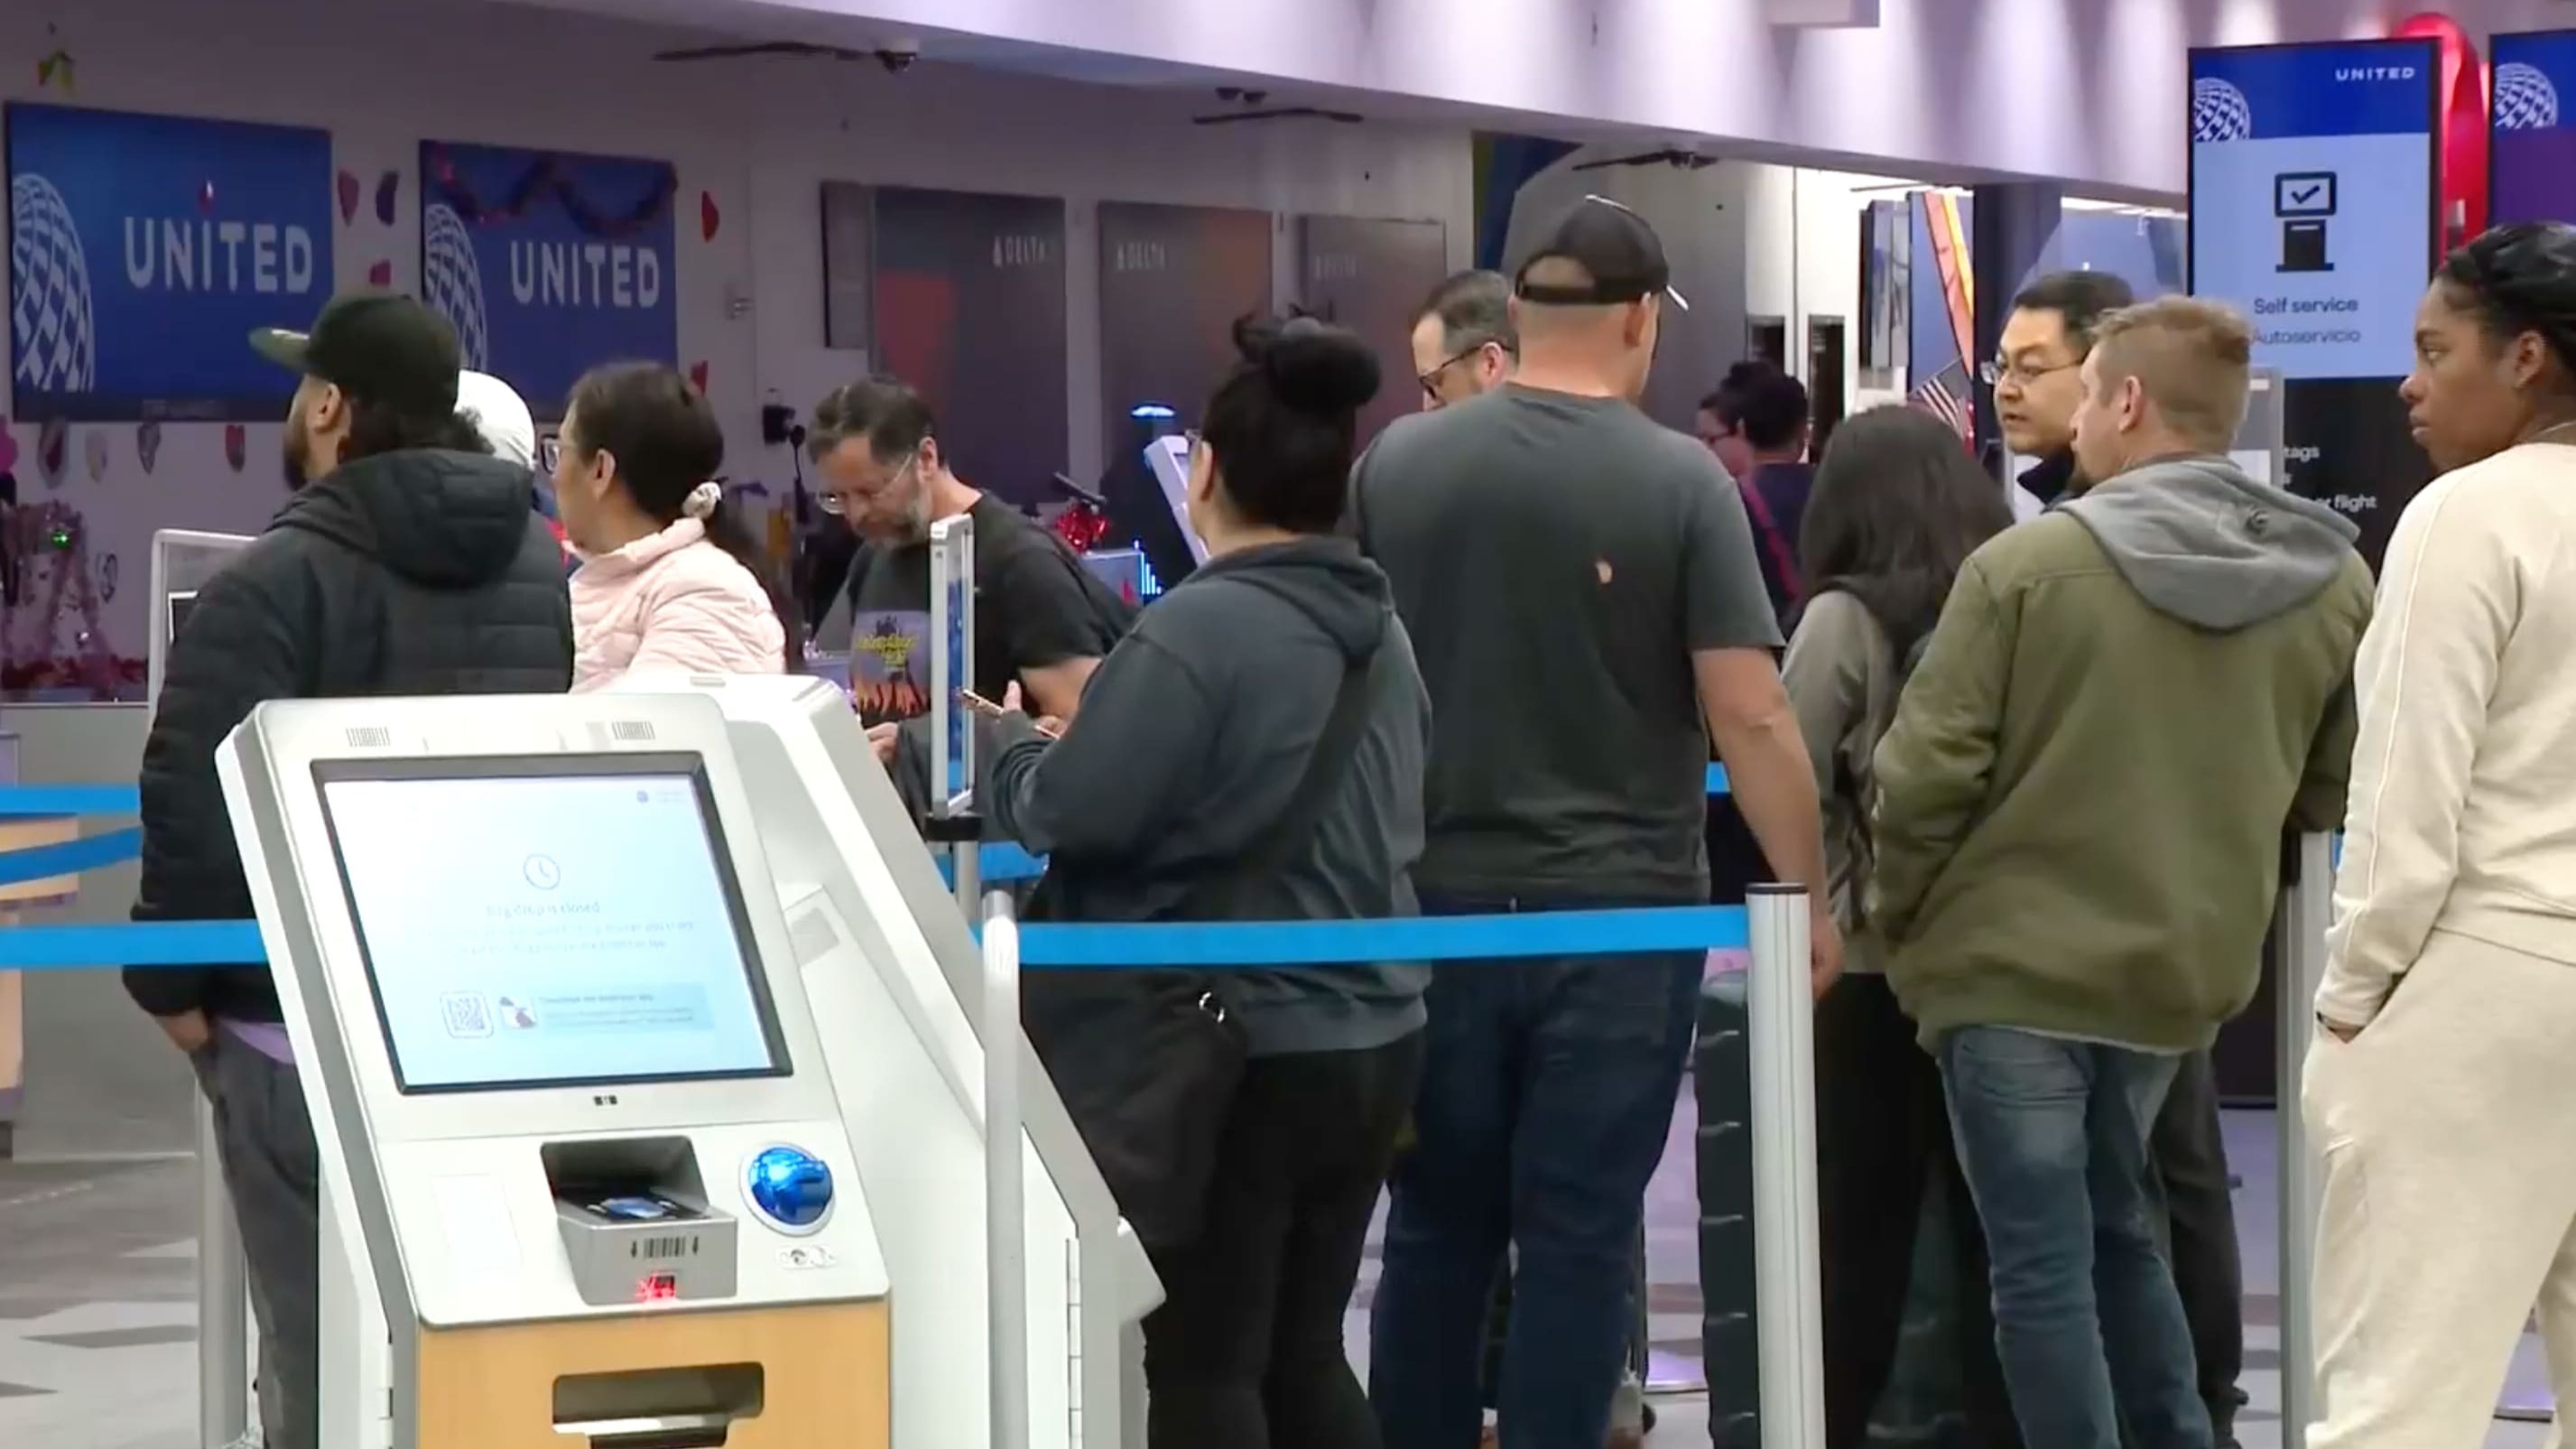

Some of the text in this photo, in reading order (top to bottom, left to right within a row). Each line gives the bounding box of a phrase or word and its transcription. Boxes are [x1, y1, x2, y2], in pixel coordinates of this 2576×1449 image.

[2335, 67, 2415, 81] UNITED
[125, 216, 312, 293] UNITED
[1005, 235, 1046, 265] DELTA
[510, 240, 660, 309] UNITED
[2254, 297, 2358, 314] Self service
[2252, 329, 2361, 344] Autoservicio
[2335, 494, 2377, 513] flight
